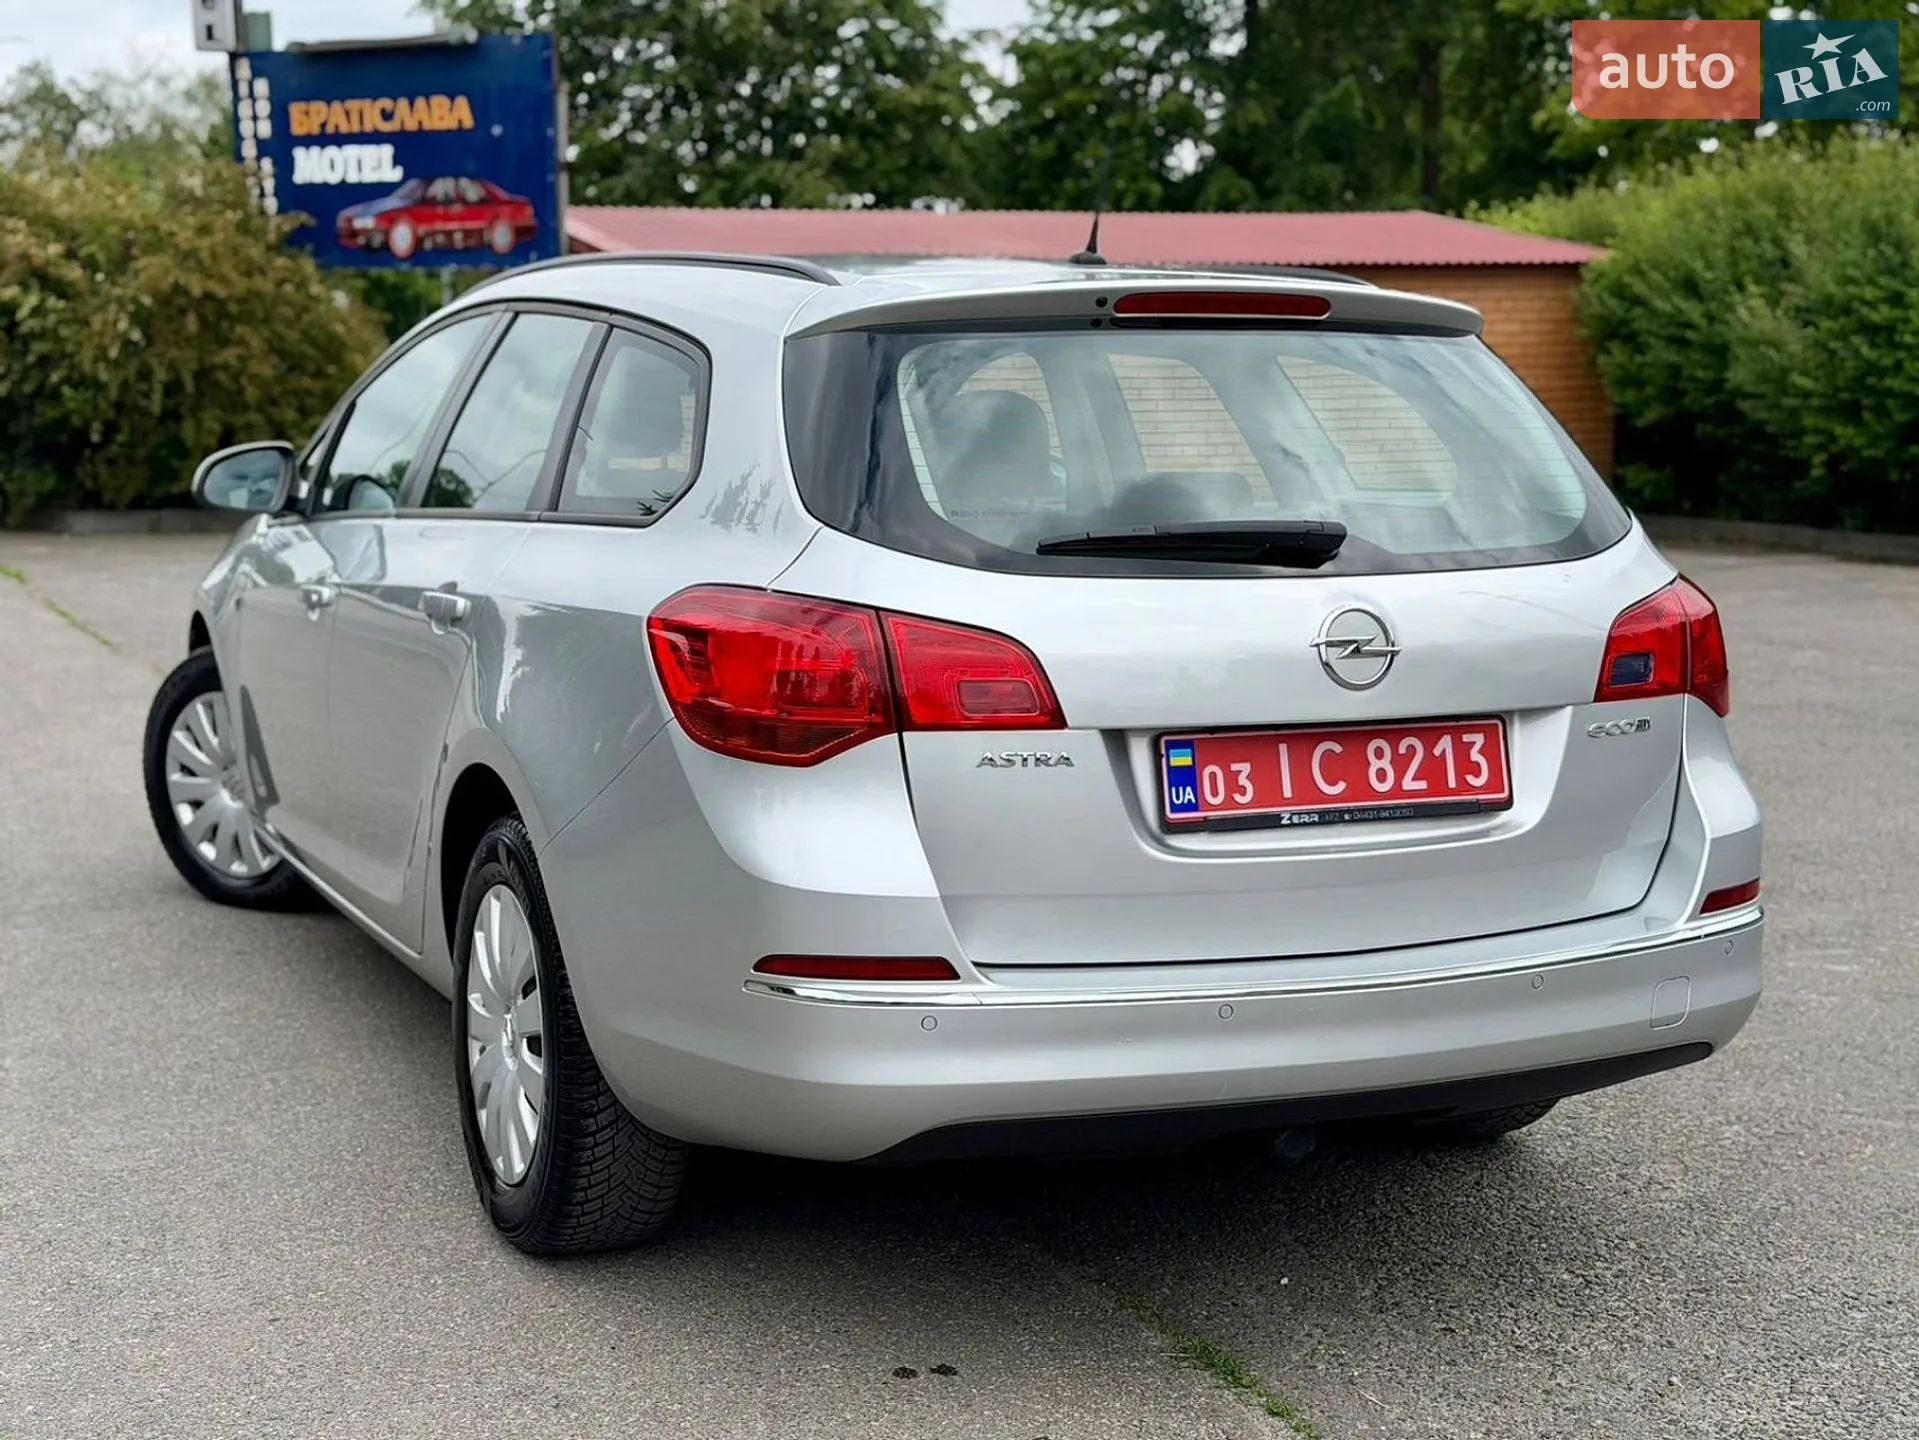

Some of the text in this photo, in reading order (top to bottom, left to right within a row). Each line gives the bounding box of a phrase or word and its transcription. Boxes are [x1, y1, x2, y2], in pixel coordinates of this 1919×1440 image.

[292, 143, 404, 185] MOTEL
[976, 751, 1075, 768] ASTRA
[1203, 763, 1254, 806] 03
[1366, 733, 1490, 794] 8213
[1172, 786, 1196, 805] UA
